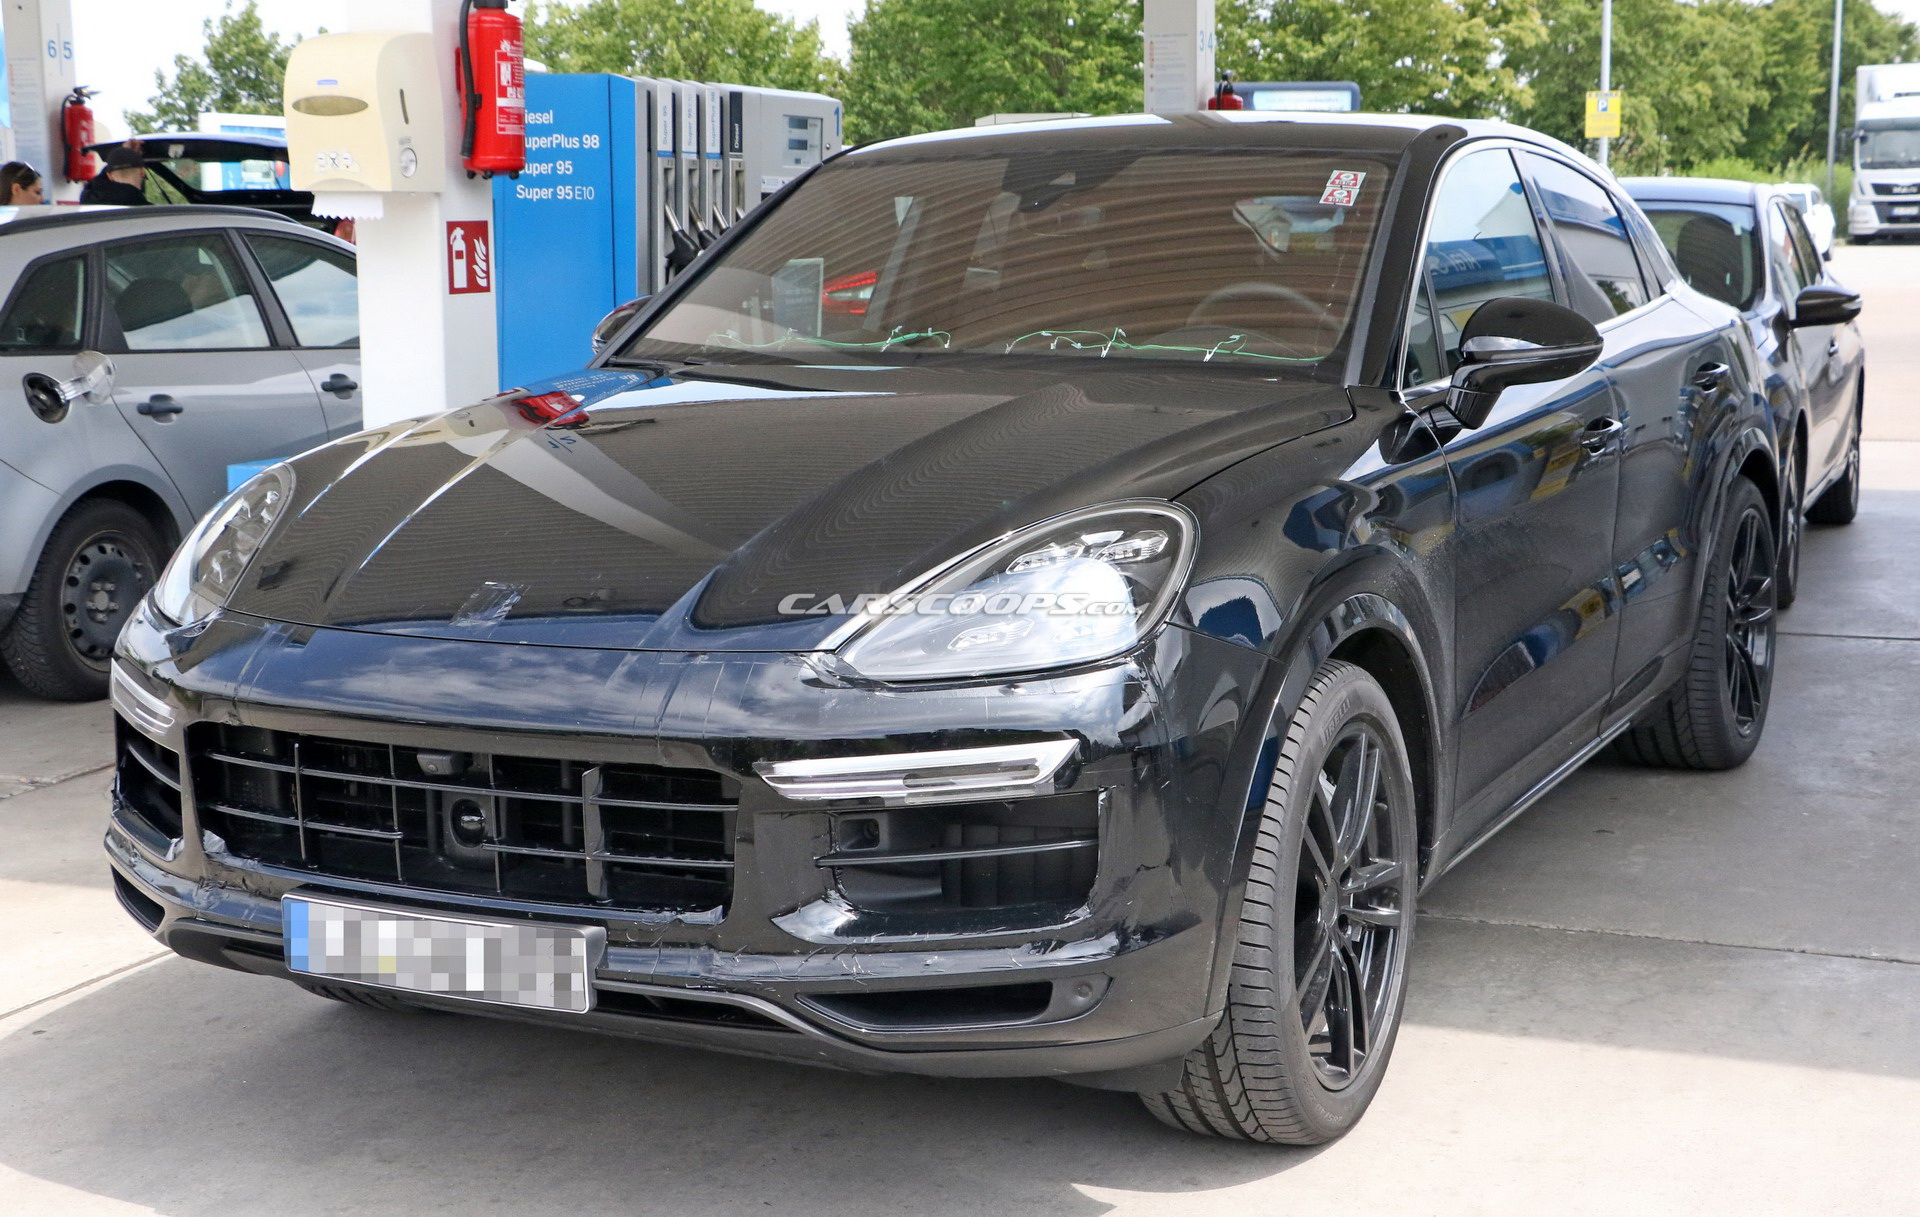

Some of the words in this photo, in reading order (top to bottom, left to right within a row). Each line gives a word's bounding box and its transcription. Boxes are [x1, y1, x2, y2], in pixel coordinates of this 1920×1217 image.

[47, 39, 57, 58] 6
[63, 41, 73, 60] 5
[524, 109, 554, 124] iesel
[834, 106, 840, 137] 1
[524, 133, 580, 151] uperPlus
[582, 134, 600, 149] 98
[556, 160, 573, 175] 95
[516, 184, 553, 202] Super
[556, 186, 573, 199] 95
[574, 186, 595, 200] E10
